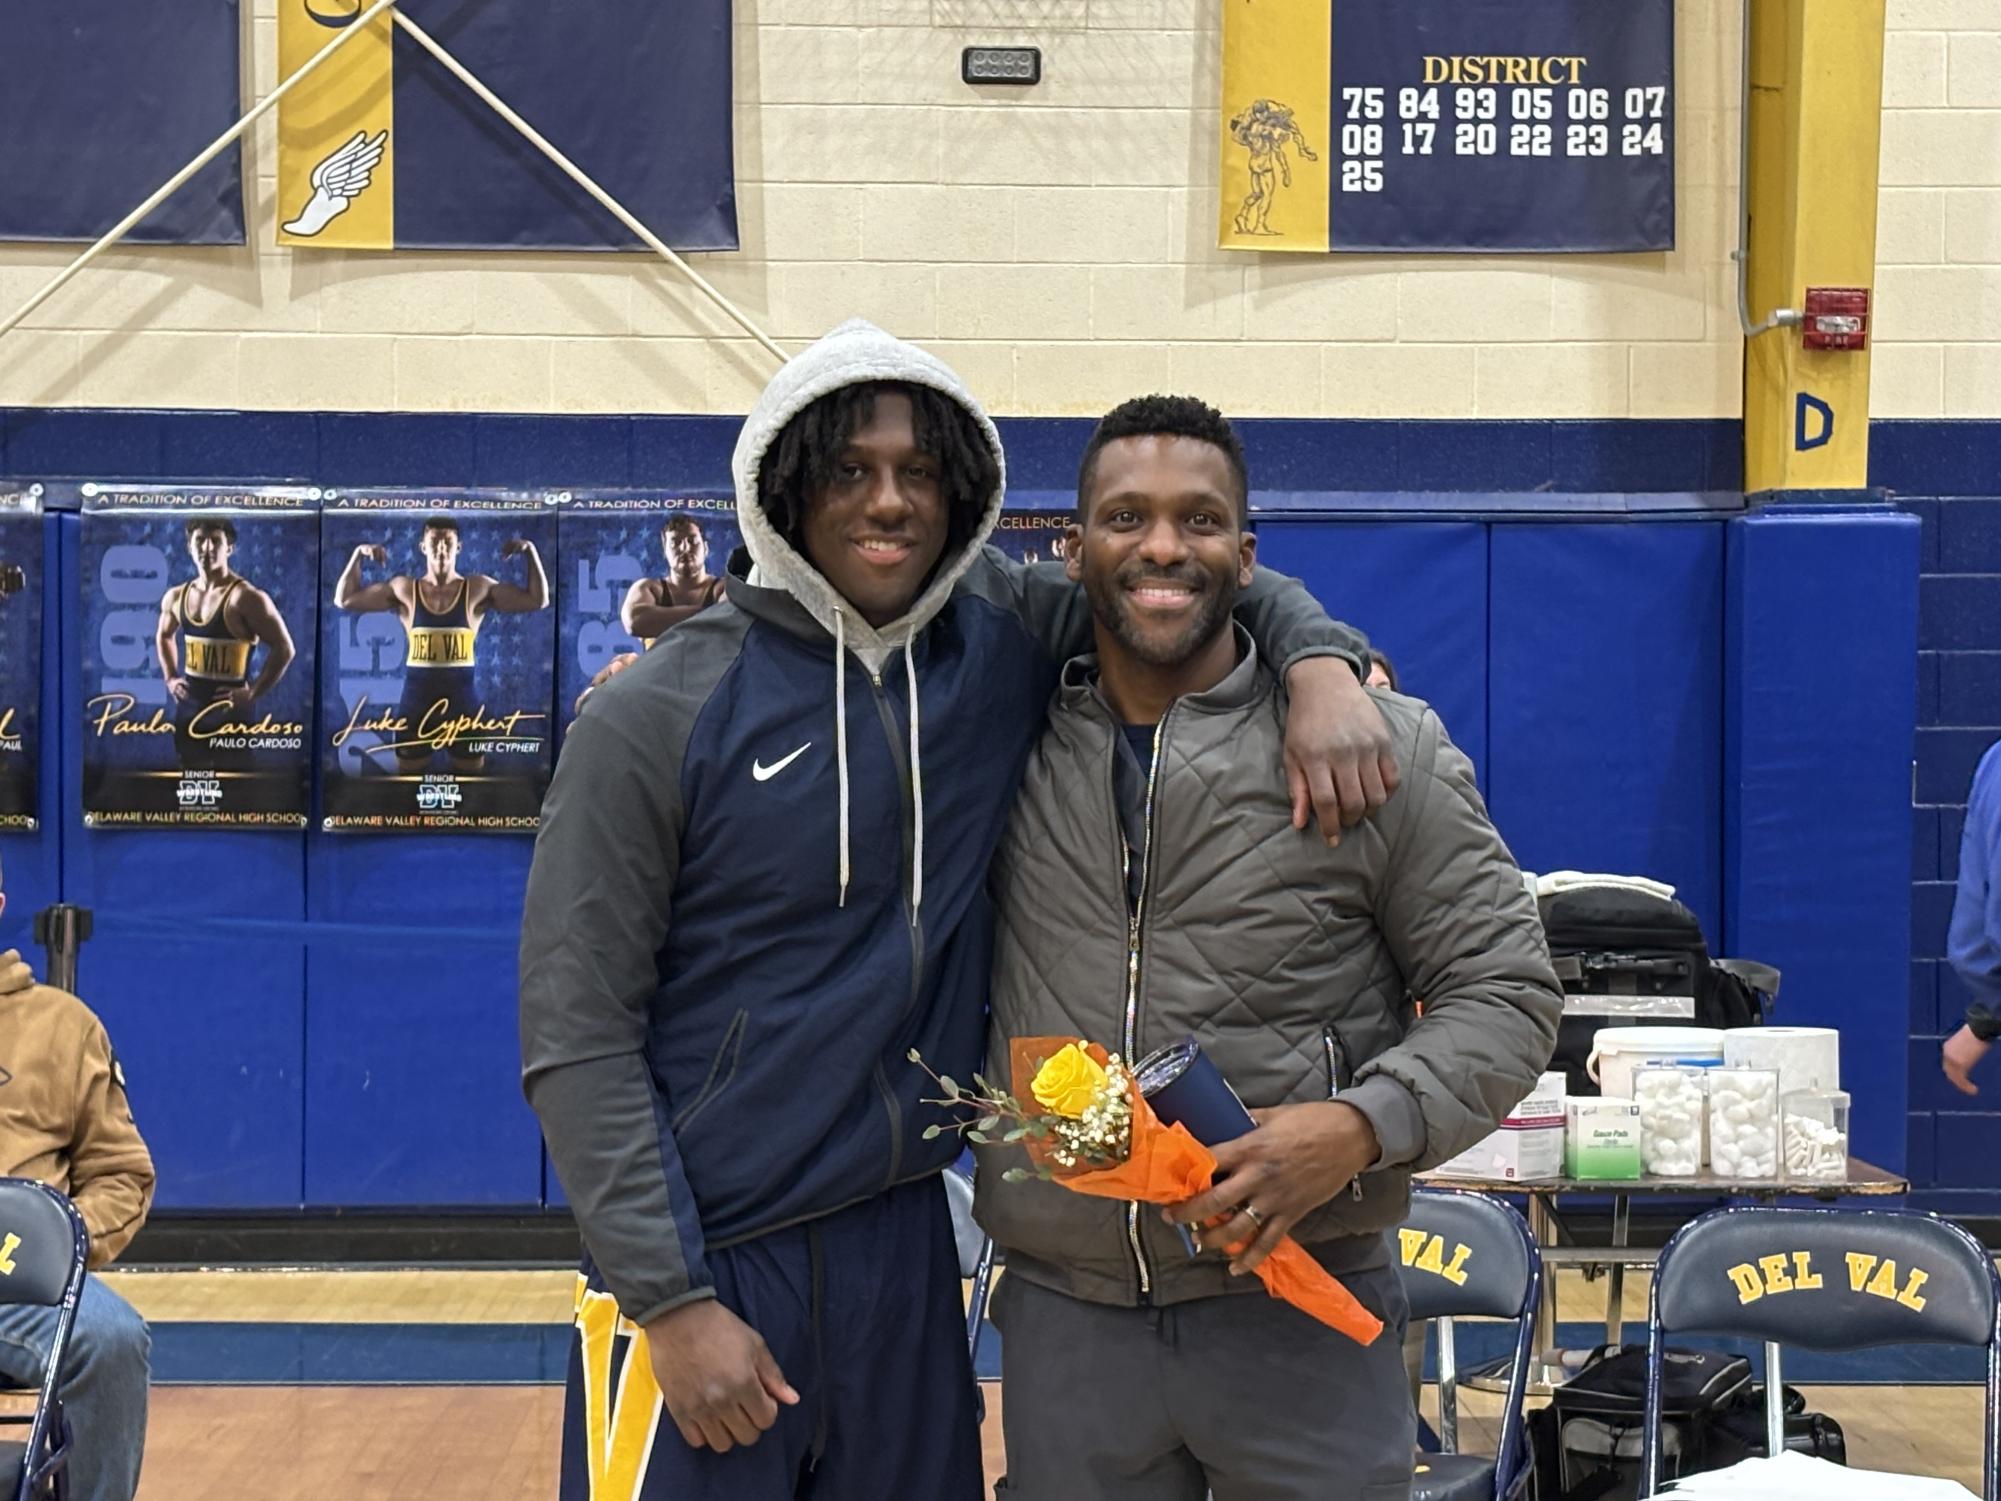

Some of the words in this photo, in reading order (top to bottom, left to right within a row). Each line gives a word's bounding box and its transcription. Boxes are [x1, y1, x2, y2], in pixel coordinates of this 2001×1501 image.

[1423, 56, 1587, 85] DISTRICT
[1342, 88, 1384, 119] 75
[1400, 88, 1440, 119] 84
[1455, 88, 1497, 119] 93
[1512, 88, 1552, 119] 05
[1568, 89, 1609, 119] 06
[1624, 87, 1666, 119] 07
[1342, 125, 1383, 155] 08
[1402, 124, 1435, 154] 17
[1456, 124, 1496, 154] 20
[1510, 124, 1551, 155] 22
[1567, 125, 1608, 155] 23
[1622, 124, 1664, 154] 24
[1342, 161, 1383, 191] 25
[1796, 391, 1834, 451] D
[98, 494, 109, 504] A
[114, 494, 187, 505] TRADITION
[191, 495, 209, 505] OF
[215, 495, 303, 507] EXCELLENCE
[337, 499, 349, 507] A
[354, 499, 426, 508] TRADITION
[430, 499, 450, 509] OF
[454, 500, 542, 510] EXCELLENCE
[573, 500, 585, 508] A
[588, 500, 660, 509] TRADITION
[664, 499, 684, 509] OF
[412, 634, 437, 661] DEL
[443, 634, 468, 661] VAL
[87, 693, 177, 737] Paulo
[188, 700, 303, 738] Cardoso
[332, 696, 408, 747] Luke
[417, 698, 546, 750] Cyphert
[210, 737, 246, 749] PAULO
[248, 737, 302, 749] CARDOSO
[469, 742, 493, 753] LUKE
[496, 742, 540, 753] CYPHERT
[184, 770, 215, 779] SENIOR
[424, 774, 455, 783] SENIOR
[145, 812, 180, 823] VALLEY
[184, 812, 236, 823] REGIONAL
[239, 813, 264, 823] HIGH
[266, 813, 303, 823] SCHOO
[385, 815, 421, 826] VALLEY
[424, 816, 475, 826] REGIONAL
[478, 816, 503, 826] HIGH
[1398, 1228, 1473, 1287] VAL
[1726, 1251, 1823, 1306] DEL
[1844, 1251, 1929, 1313] VAL
